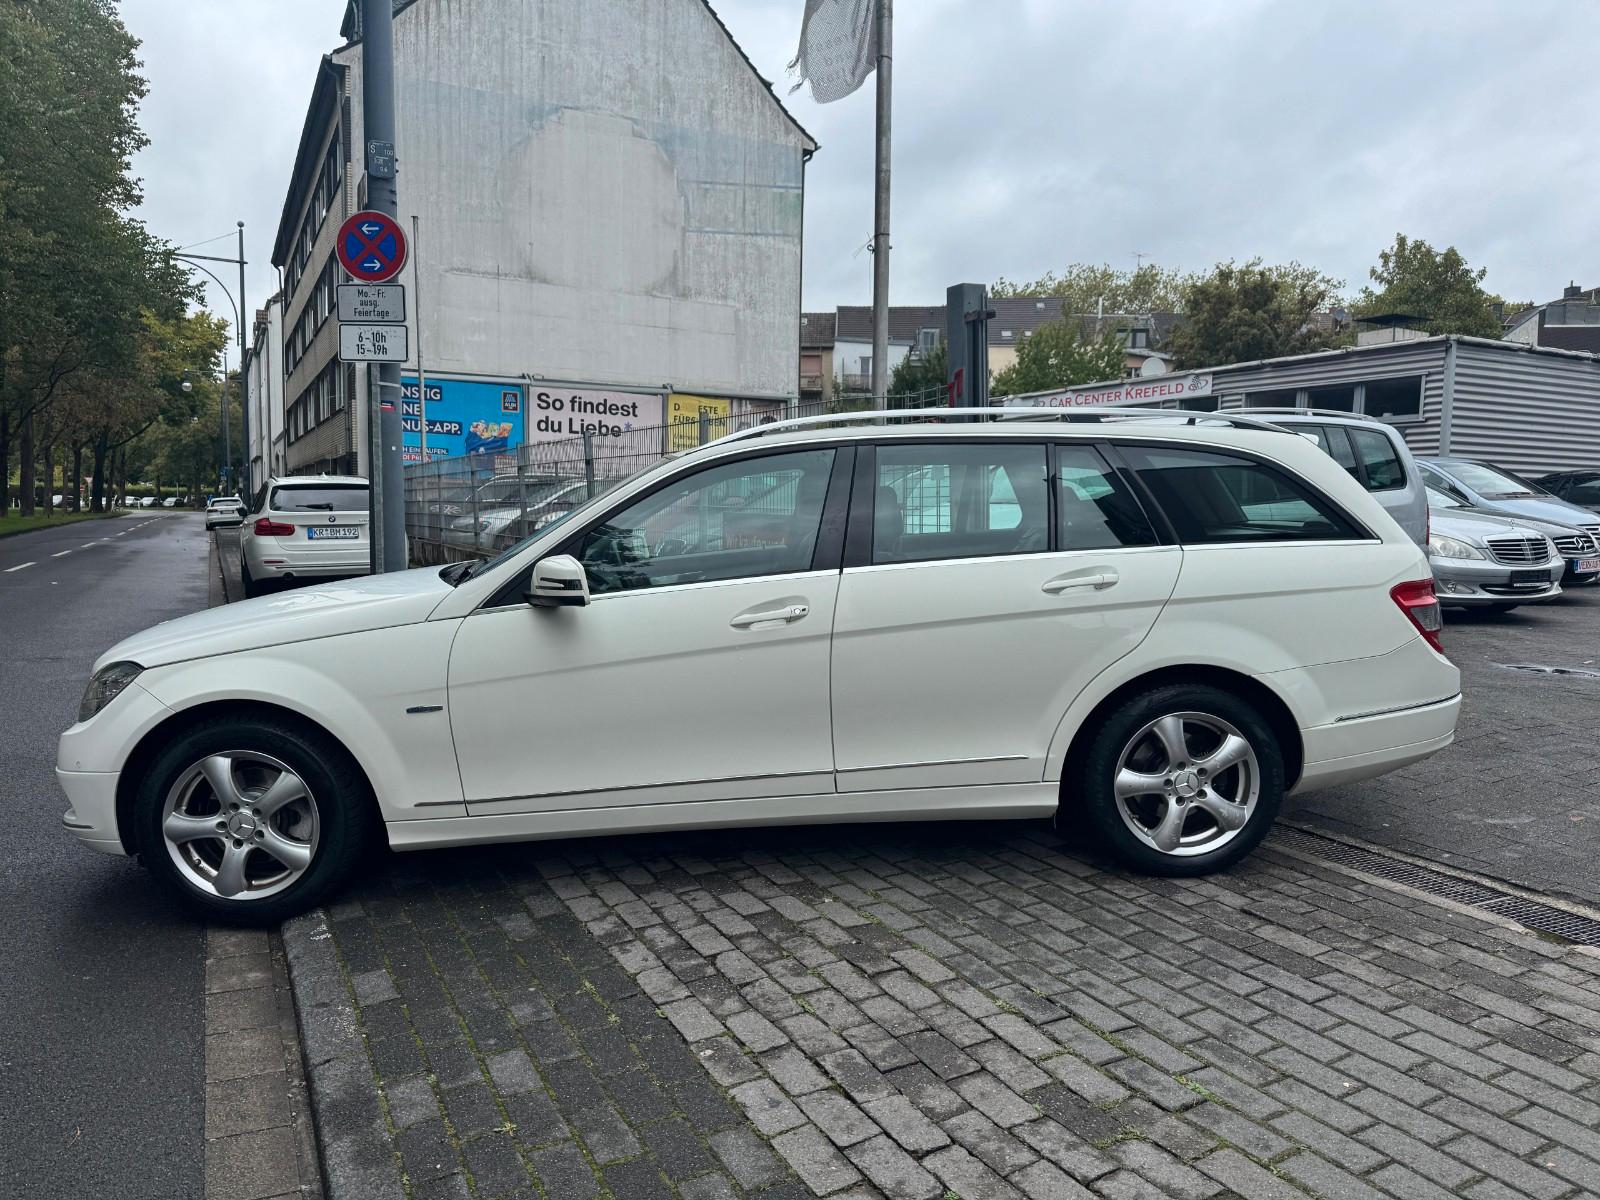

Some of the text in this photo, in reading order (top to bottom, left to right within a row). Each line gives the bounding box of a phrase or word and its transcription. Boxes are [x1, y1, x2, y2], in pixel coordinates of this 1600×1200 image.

[360, 300, 380, 309] ausg.
[353, 307, 390, 320] Feiertage
[1049, 383, 1185, 407] CAR CENTER KREFELD
[536, 392, 639, 418] So findest
[536, 415, 562, 433] du
[313, 528, 324, 536] KR
[342, 528, 358, 536] 192
